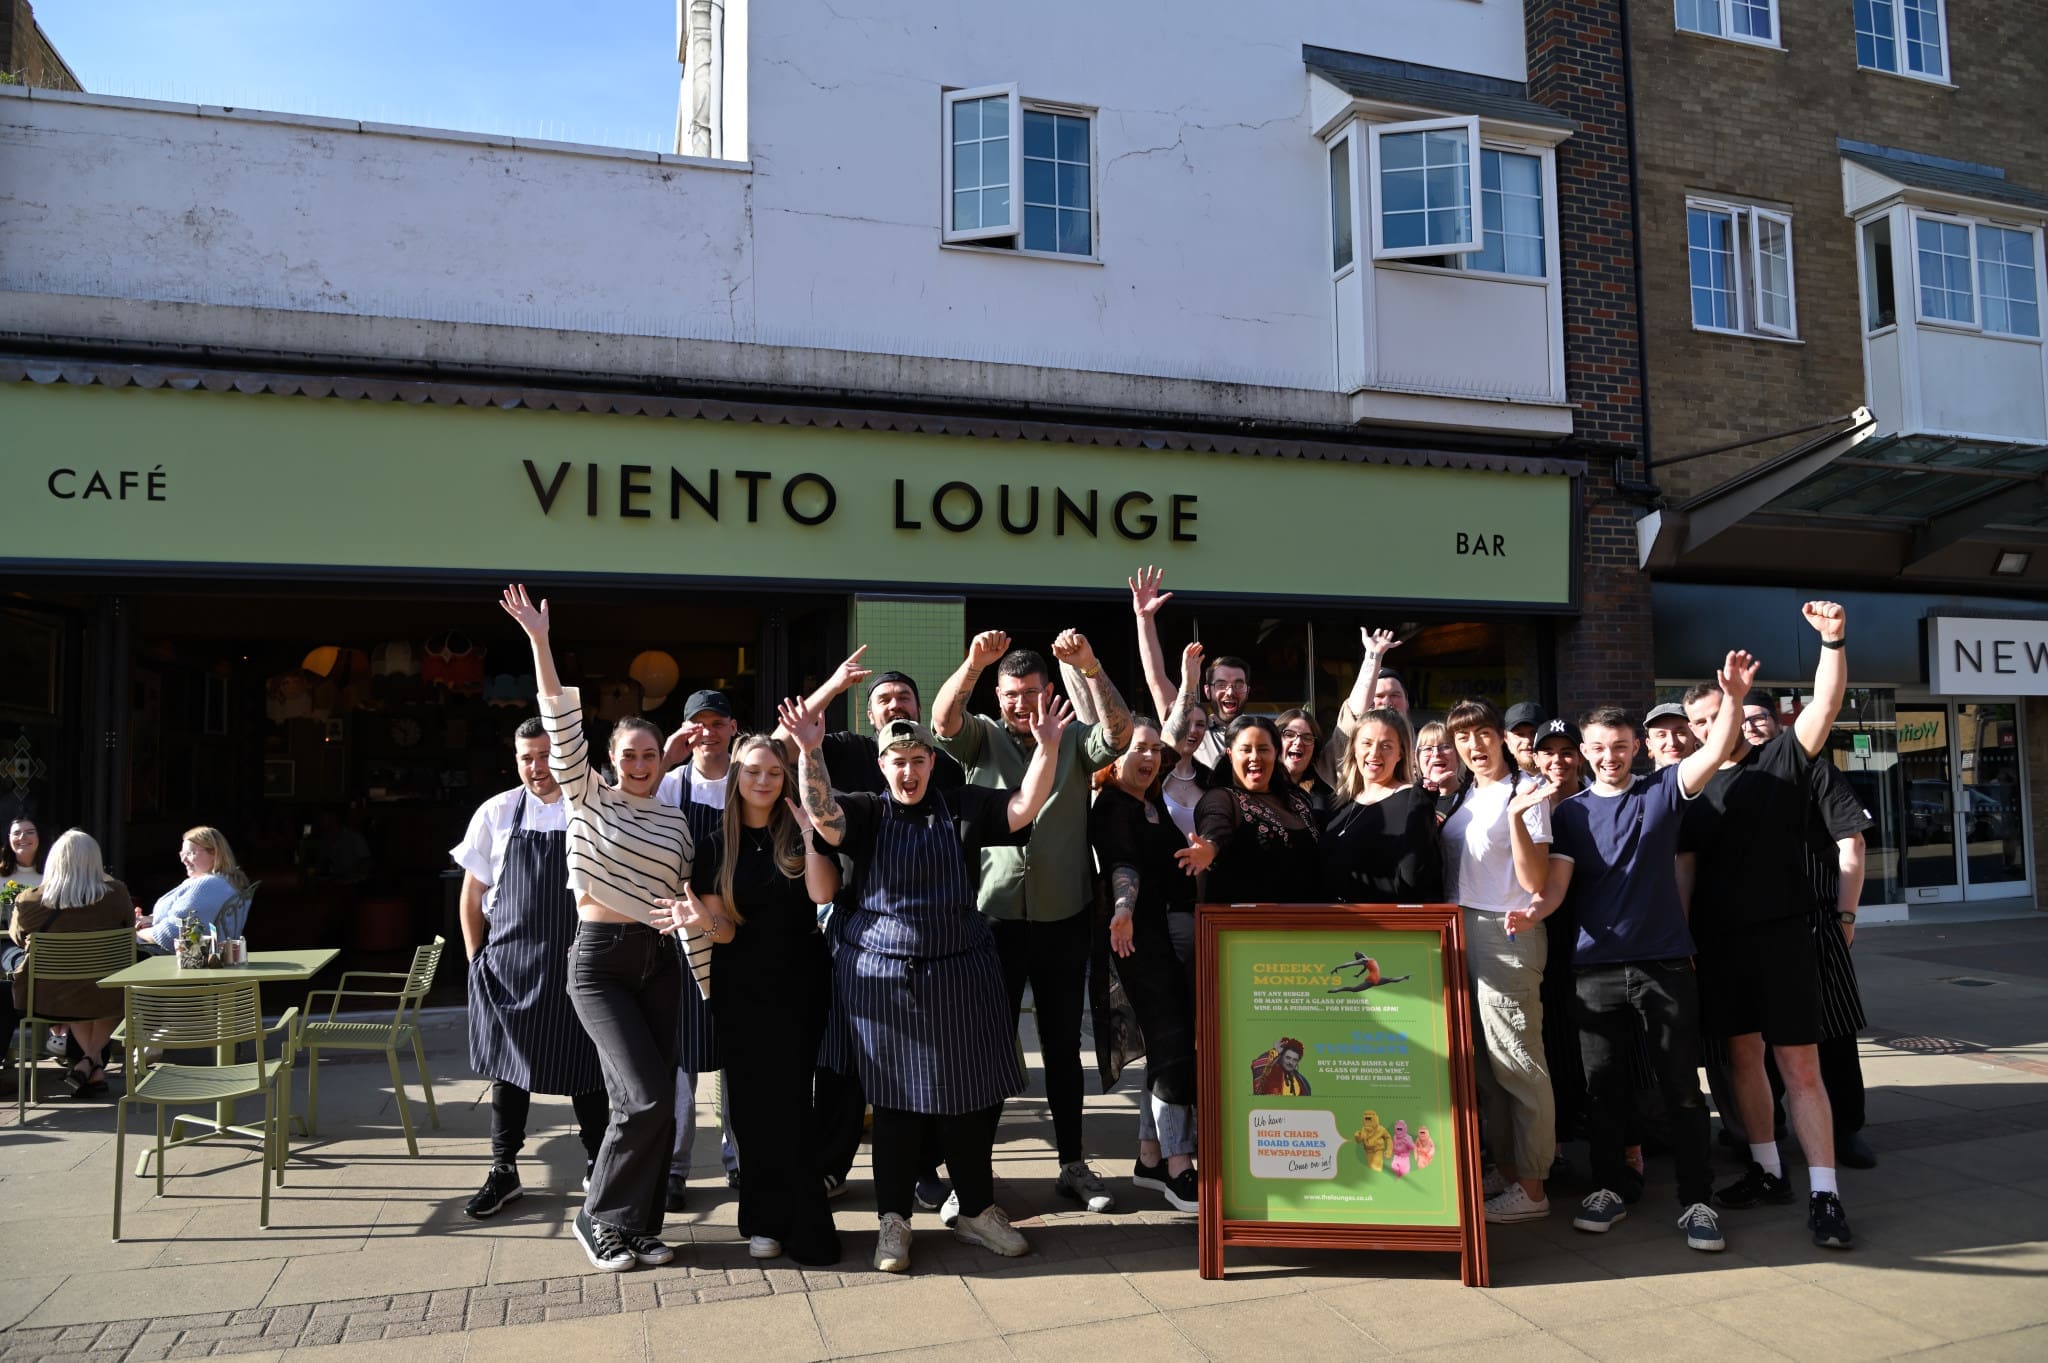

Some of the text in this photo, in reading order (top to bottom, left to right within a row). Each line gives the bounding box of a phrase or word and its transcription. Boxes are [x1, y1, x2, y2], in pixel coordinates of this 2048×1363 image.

[47, 464, 167, 501] CAFÉ
[522, 460, 1199, 542] VIENTO LOUNGE
[1456, 532, 1506, 557] BAR
[1252, 963, 1326, 974] CHEEKY
[1254, 975, 1342, 986] MONDAYS
